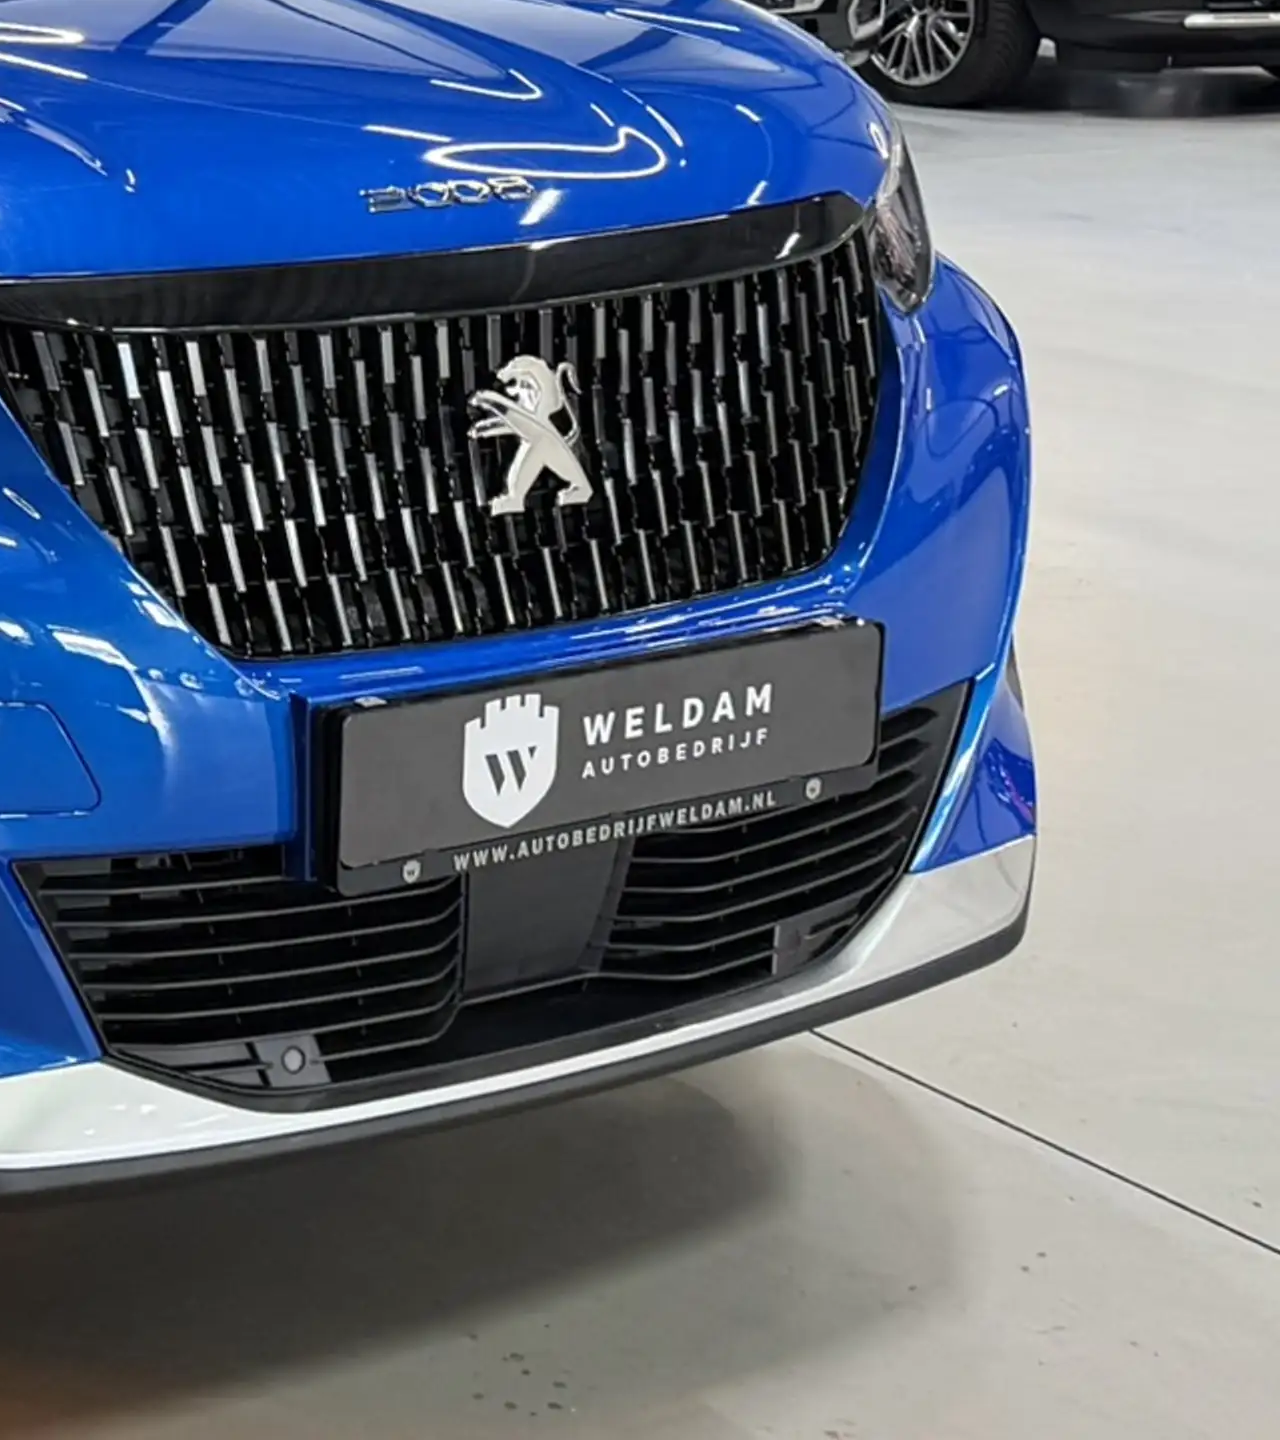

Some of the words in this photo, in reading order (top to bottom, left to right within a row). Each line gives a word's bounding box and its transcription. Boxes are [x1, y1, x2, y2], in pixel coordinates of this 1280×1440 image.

[582, 682, 773, 746] WELDAM
[581, 726, 770, 780] AUTOBEDRIJF
[452, 789, 777, 872] WWW.AUTOBEDRIJFWELDAM.NL
